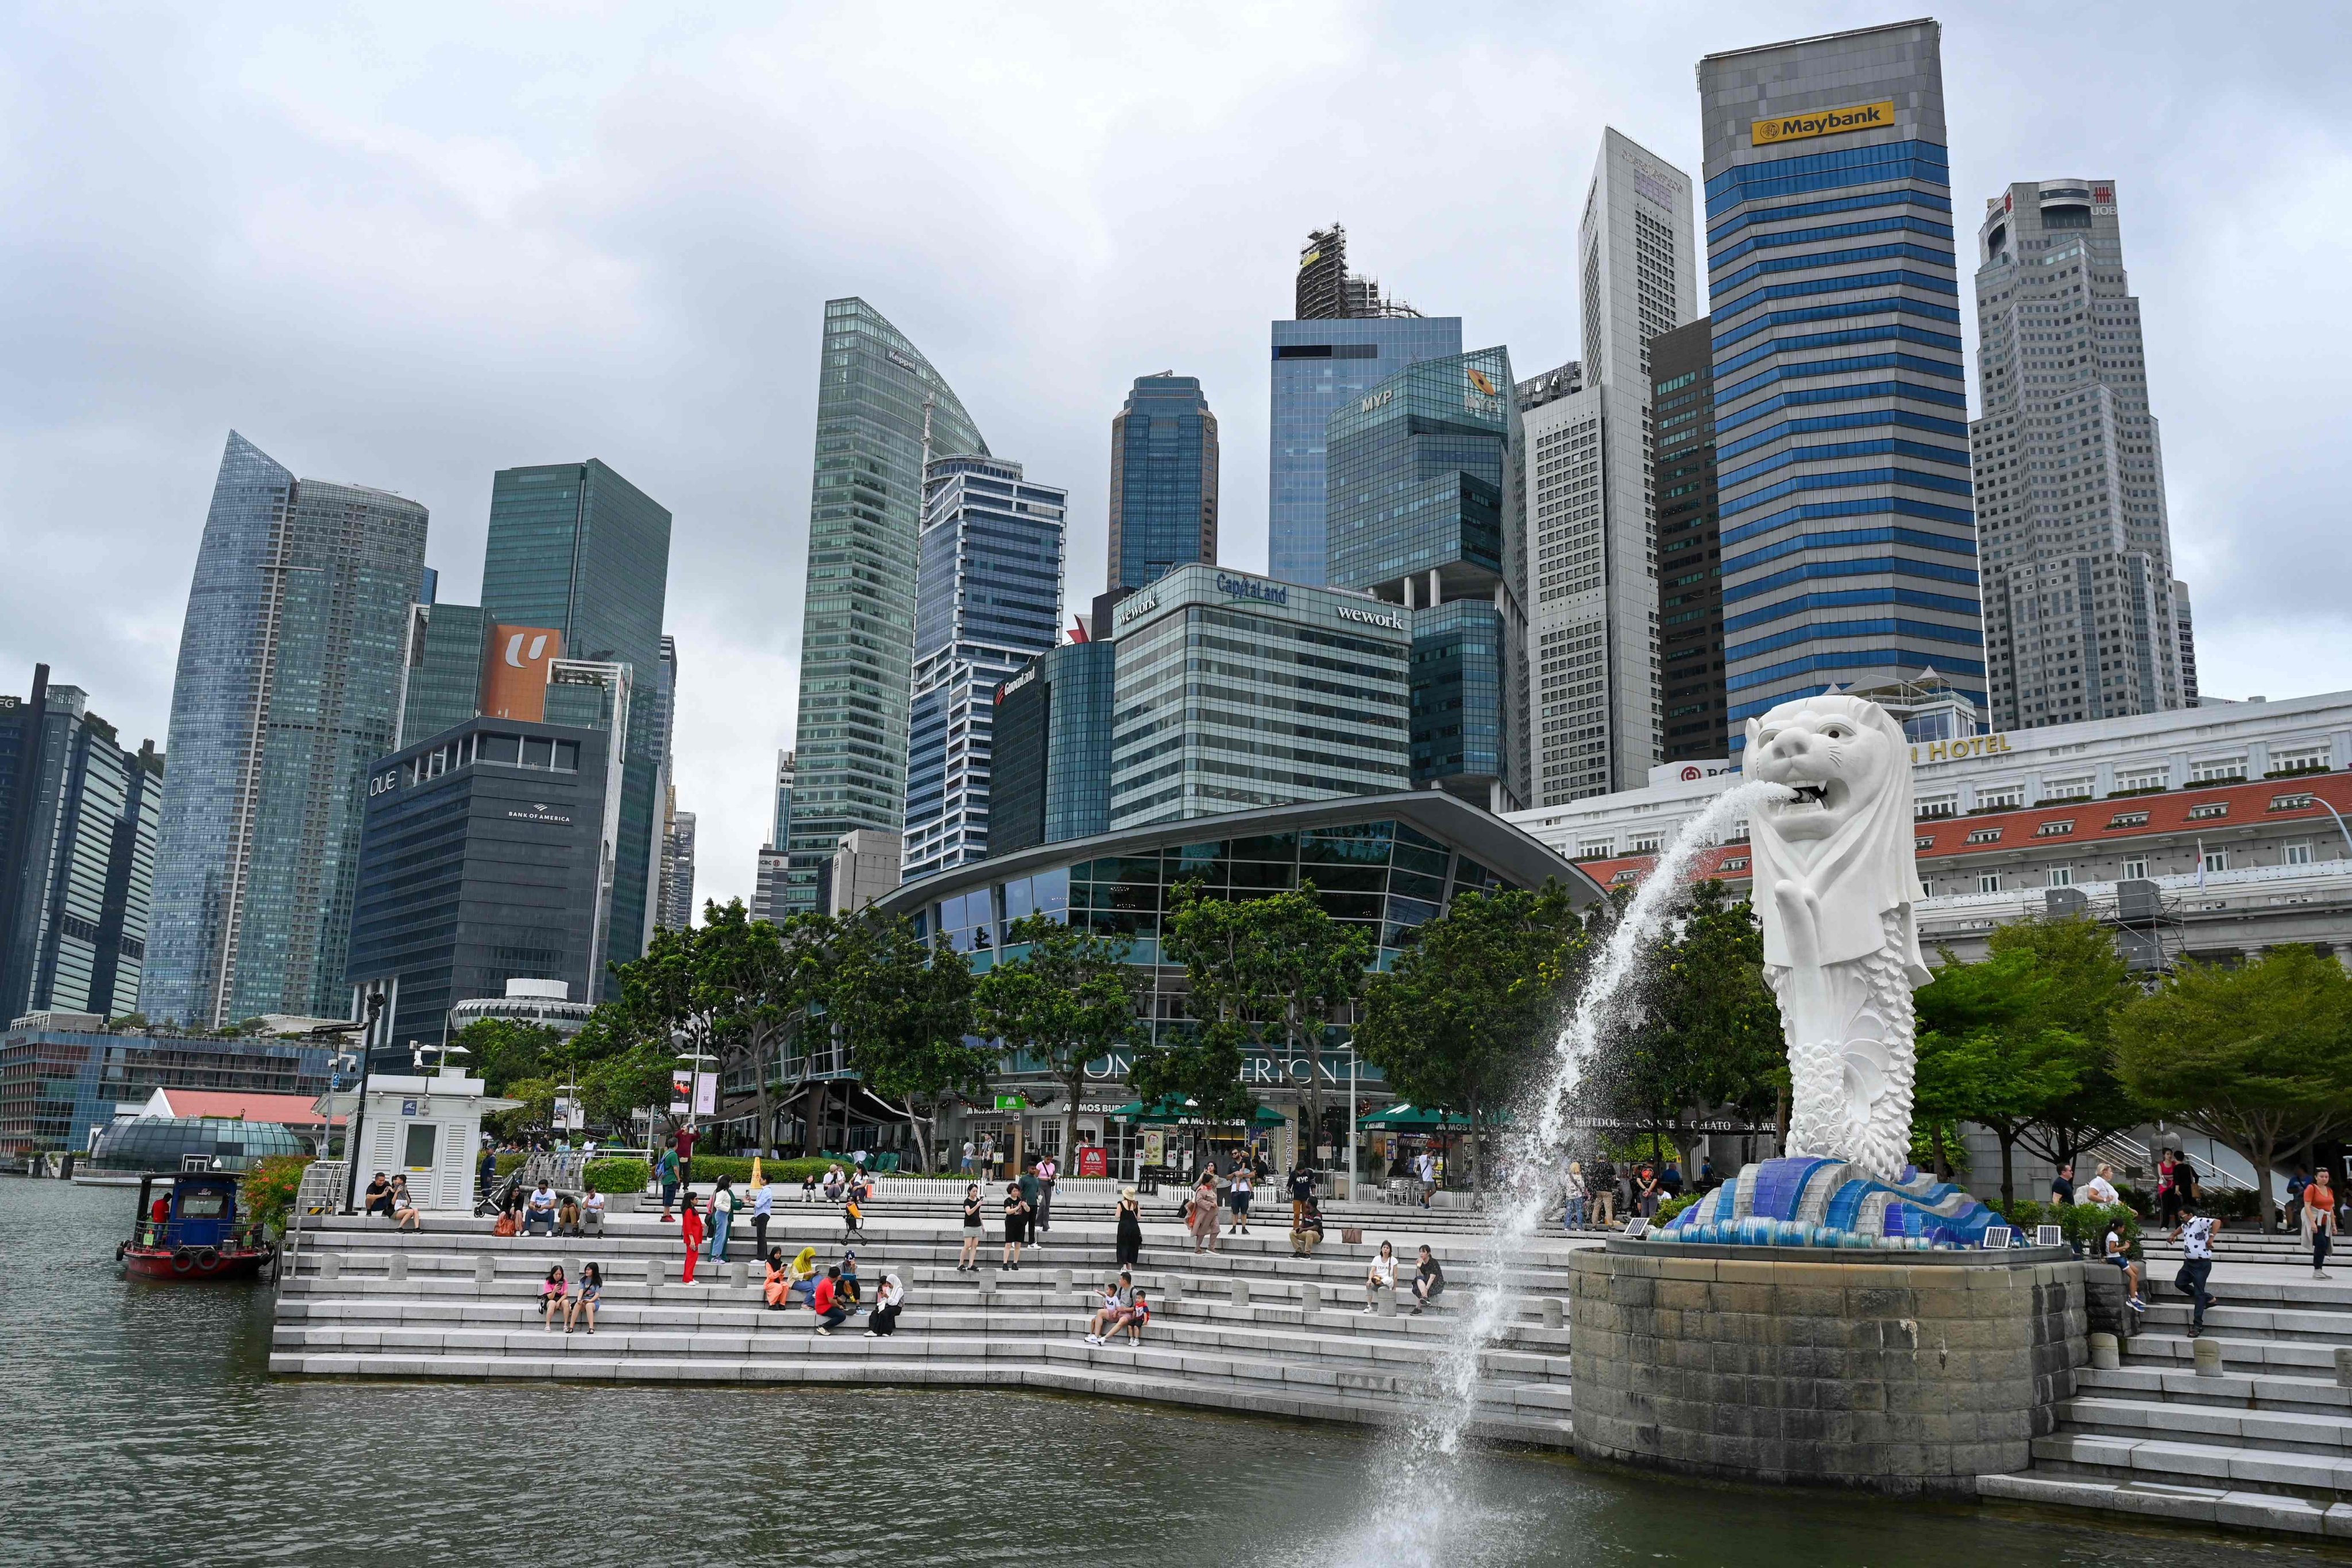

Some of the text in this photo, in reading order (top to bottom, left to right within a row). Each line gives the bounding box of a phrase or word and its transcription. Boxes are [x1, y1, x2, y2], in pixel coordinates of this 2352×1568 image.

[1782, 107, 1881, 136] Maybank
[2091, 206, 2117, 215] UOB
[889, 350, 915, 370] Keppel
[1362, 389, 1393, 414] MYP
[1465, 395, 1499, 412] MYP
[1217, 573, 1286, 604] CapitaLand
[1118, 590, 1156, 625] wework
[1337, 606, 1404, 629] wework
[1005, 666, 1035, 696] GuocoLand
[1929, 734, 2011, 762] HOTEL
[370, 770, 396, 797] OUE
[1079, 1104, 1100, 1113] MOS
[1575, 1117, 1620, 1127] HOTDOG
